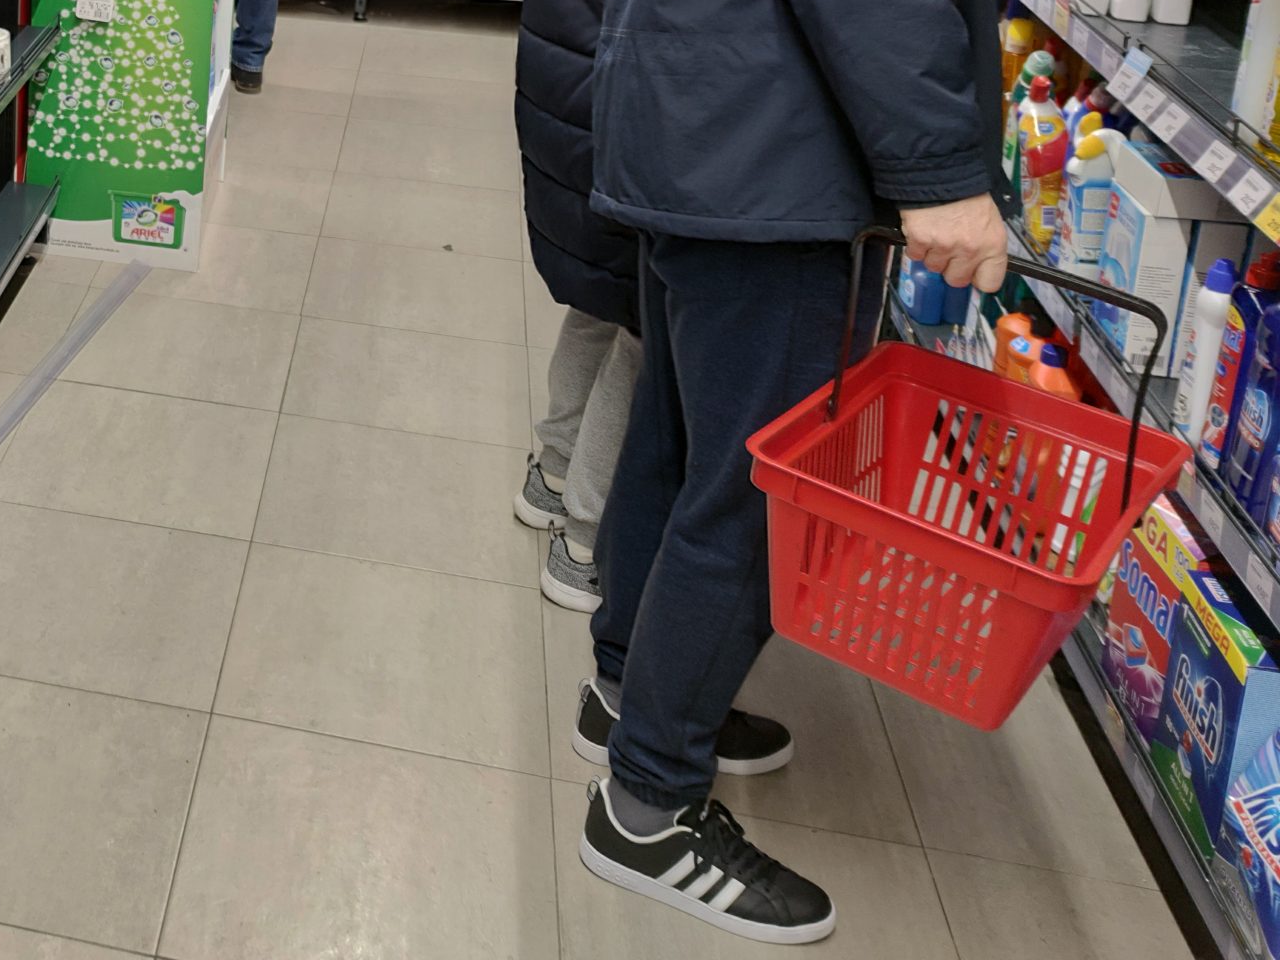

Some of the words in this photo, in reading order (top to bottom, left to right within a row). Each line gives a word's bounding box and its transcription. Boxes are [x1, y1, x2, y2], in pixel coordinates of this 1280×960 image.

[130, 227, 165, 242] ARIEL
[1141, 515, 1170, 564] GA
[1195, 596, 1231, 657] MEGA
[1174, 653, 1218, 757] finish
